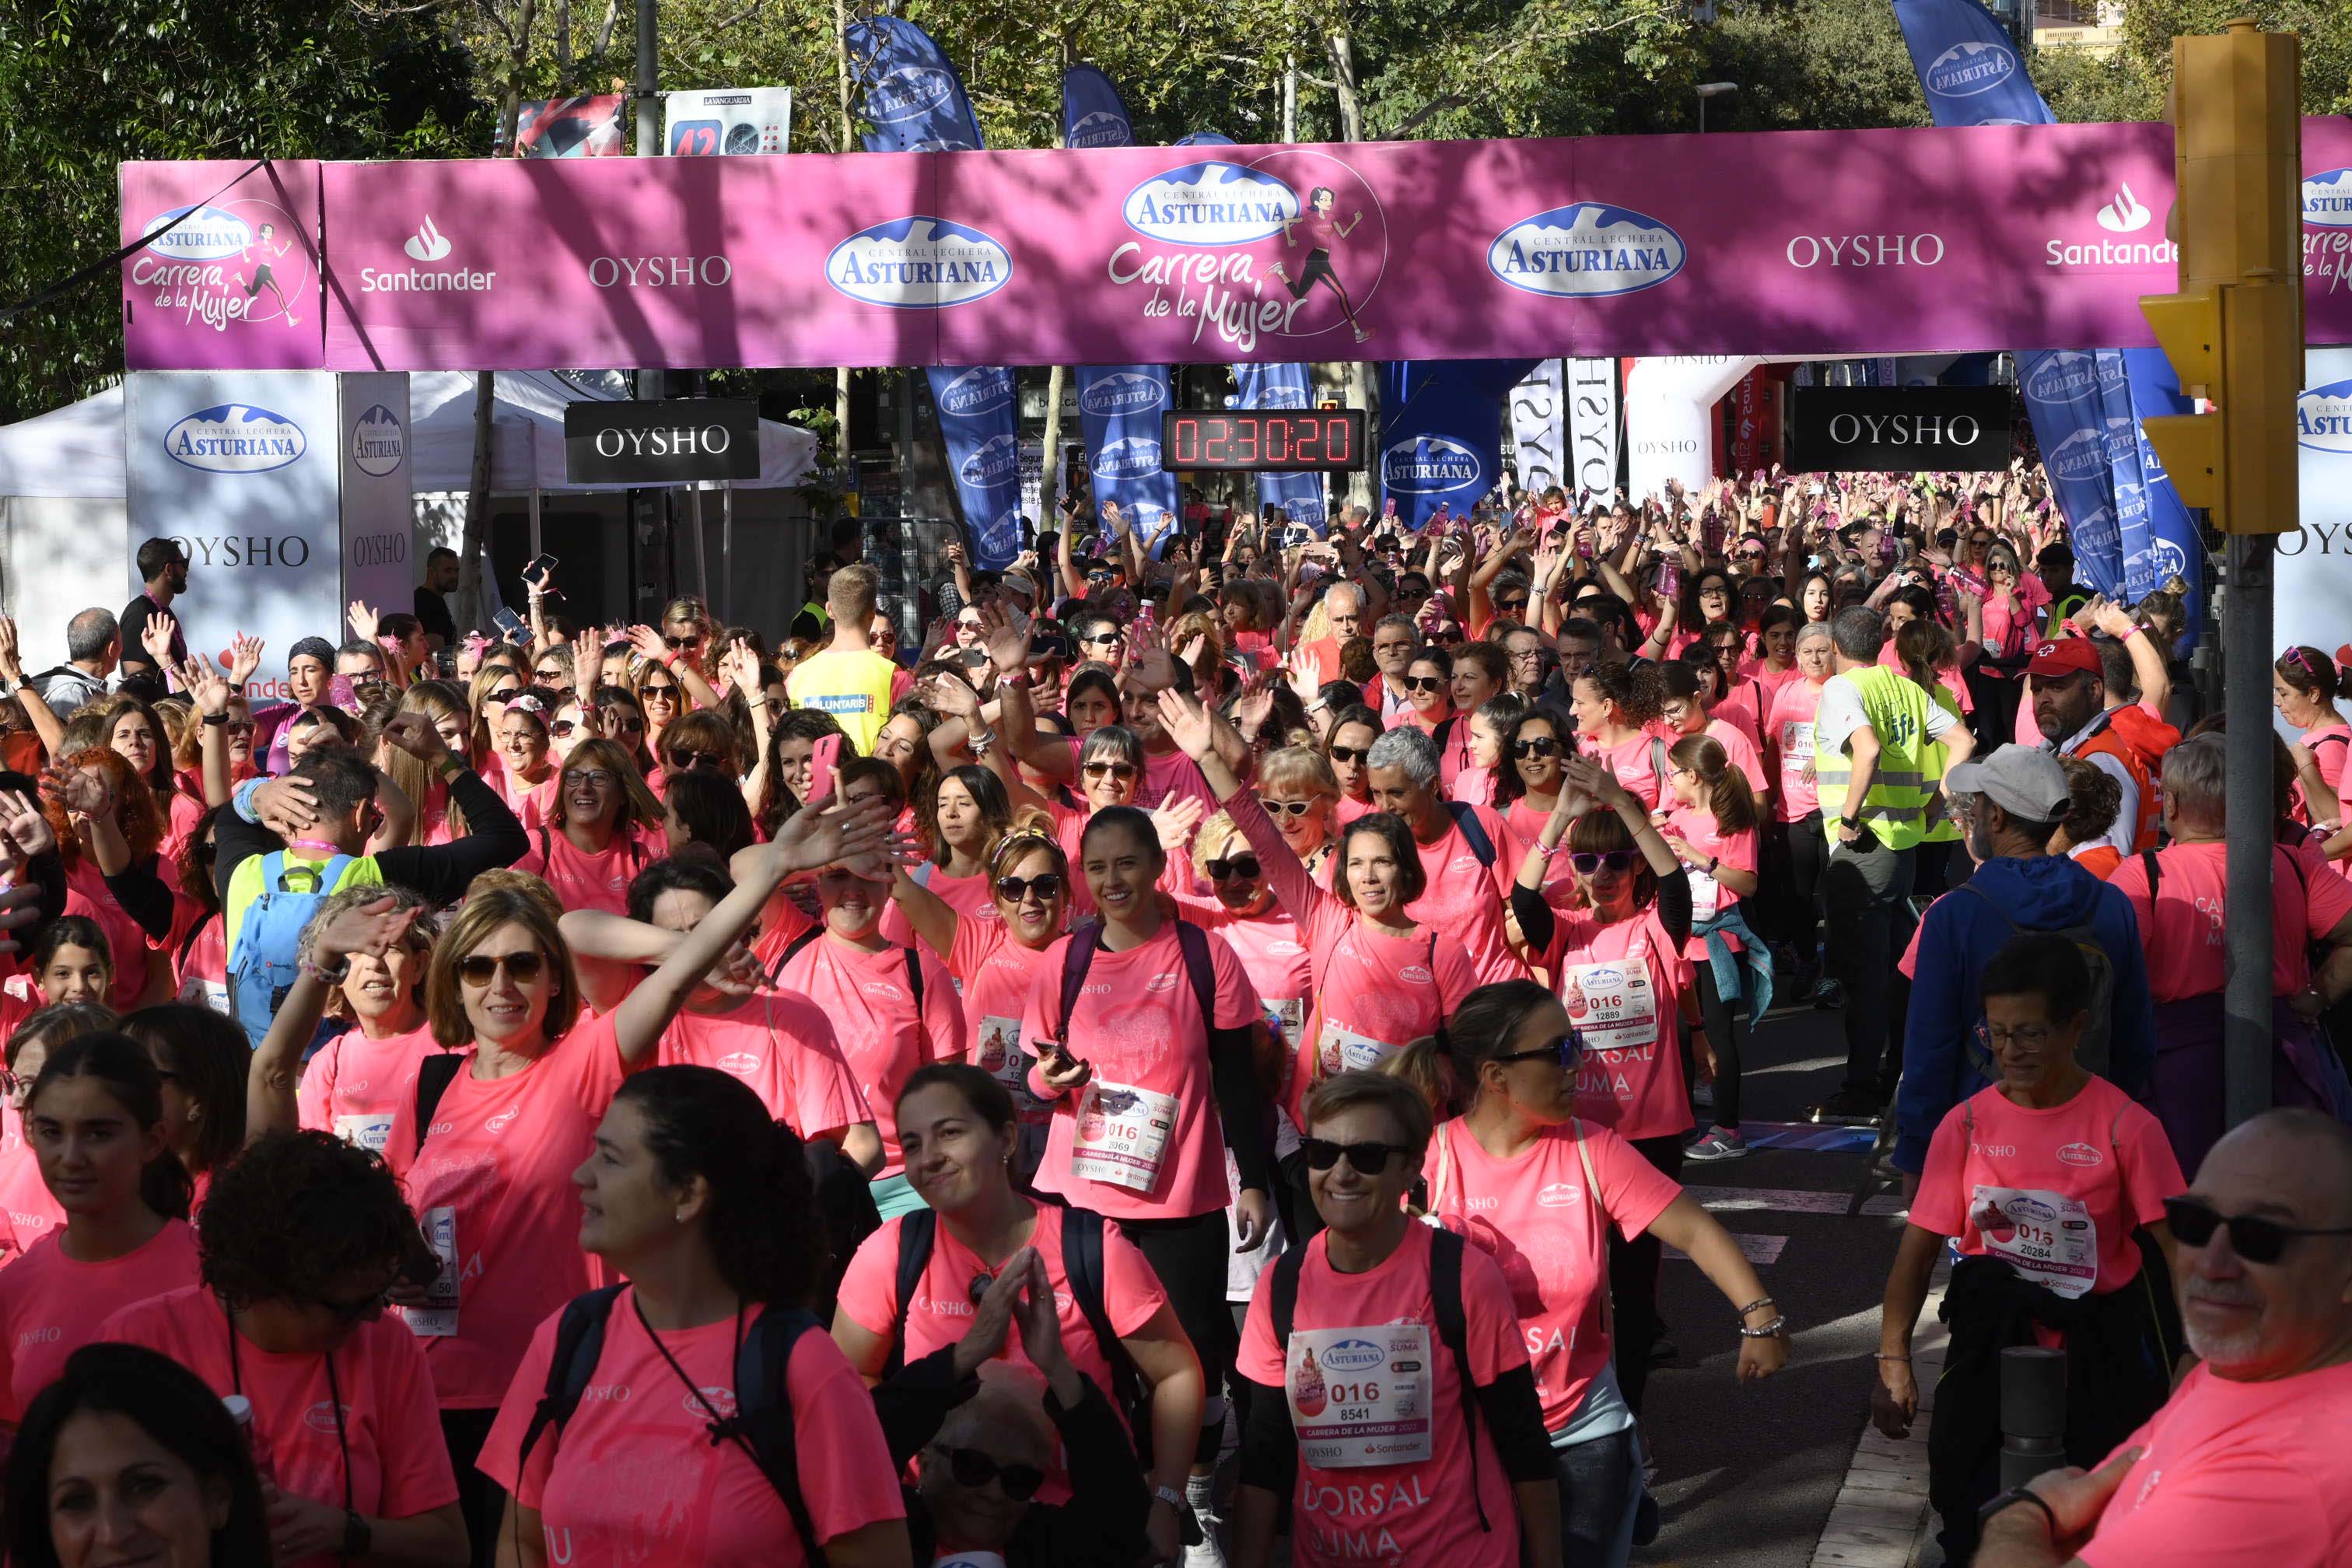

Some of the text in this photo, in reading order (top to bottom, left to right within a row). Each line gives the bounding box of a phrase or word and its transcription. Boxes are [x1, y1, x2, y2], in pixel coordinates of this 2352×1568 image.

[1137, 194, 1286, 224] ASTURIANA
[1534, 234, 1664, 246] CENTRAL LECHERA
[1787, 233, 1944, 268] OYSHO
[869, 248, 929, 257] CENTRAL
[1503, 238, 1671, 274] ASTURIANA
[132, 257, 224, 288] Carrera
[588, 255, 731, 289] OYSHO
[840, 251, 998, 285] ASTURIANA
[1108, 242, 1254, 285] Carrera
[2319, 254, 2333, 276] la
[362, 268, 495, 292] Santander
[155, 285, 259, 331] de la Mujer
[1143, 281, 1307, 352] de la Mujer
[1176, 418, 1349, 462] 02:30:20
[1829, 414, 1979, 446] OYSHO
[175, 429, 296, 457] ASTURIANA
[355, 432, 401, 460] ASTURIANA
[596, 425, 730, 457] OYSHO
[1637, 439, 1697, 453] OYSHO
[1384, 464, 1472, 481] ASTURIANA
[353, 532, 405, 568] OYSHO
[805, 698, 865, 711] VOLUNTARIS
[1586, 977, 1621, 986] ASTURIANA
[1590, 995, 1622, 1010] 016
[1595, 1011, 1620, 1020] 12889
[1108, 1123, 1137, 1139] 016
[1120, 1156, 1141, 1166] MUJER
[2060, 1150, 2100, 1164] ASTURIANA
[1540, 1190, 1580, 1204] ASTURIANA
[2010, 1205, 2053, 1220] ASTURIANA
[2021, 1244, 2051, 1258] 20284
[2043, 1264, 2067, 1273] MUJER
[919, 1295, 974, 1316] OYSHO
[1327, 1351, 1380, 1366] ASTURIANA
[1331, 1381, 1380, 1403] 016
[1341, 1408, 1370, 1421] 8541
[1307, 1427, 1340, 1437] CARRERA
[1367, 1425, 1395, 1433] MUJER
[1307, 1441, 1421, 1458] OYSHO Santander
[1304, 1475, 1431, 1516] DORSAL
